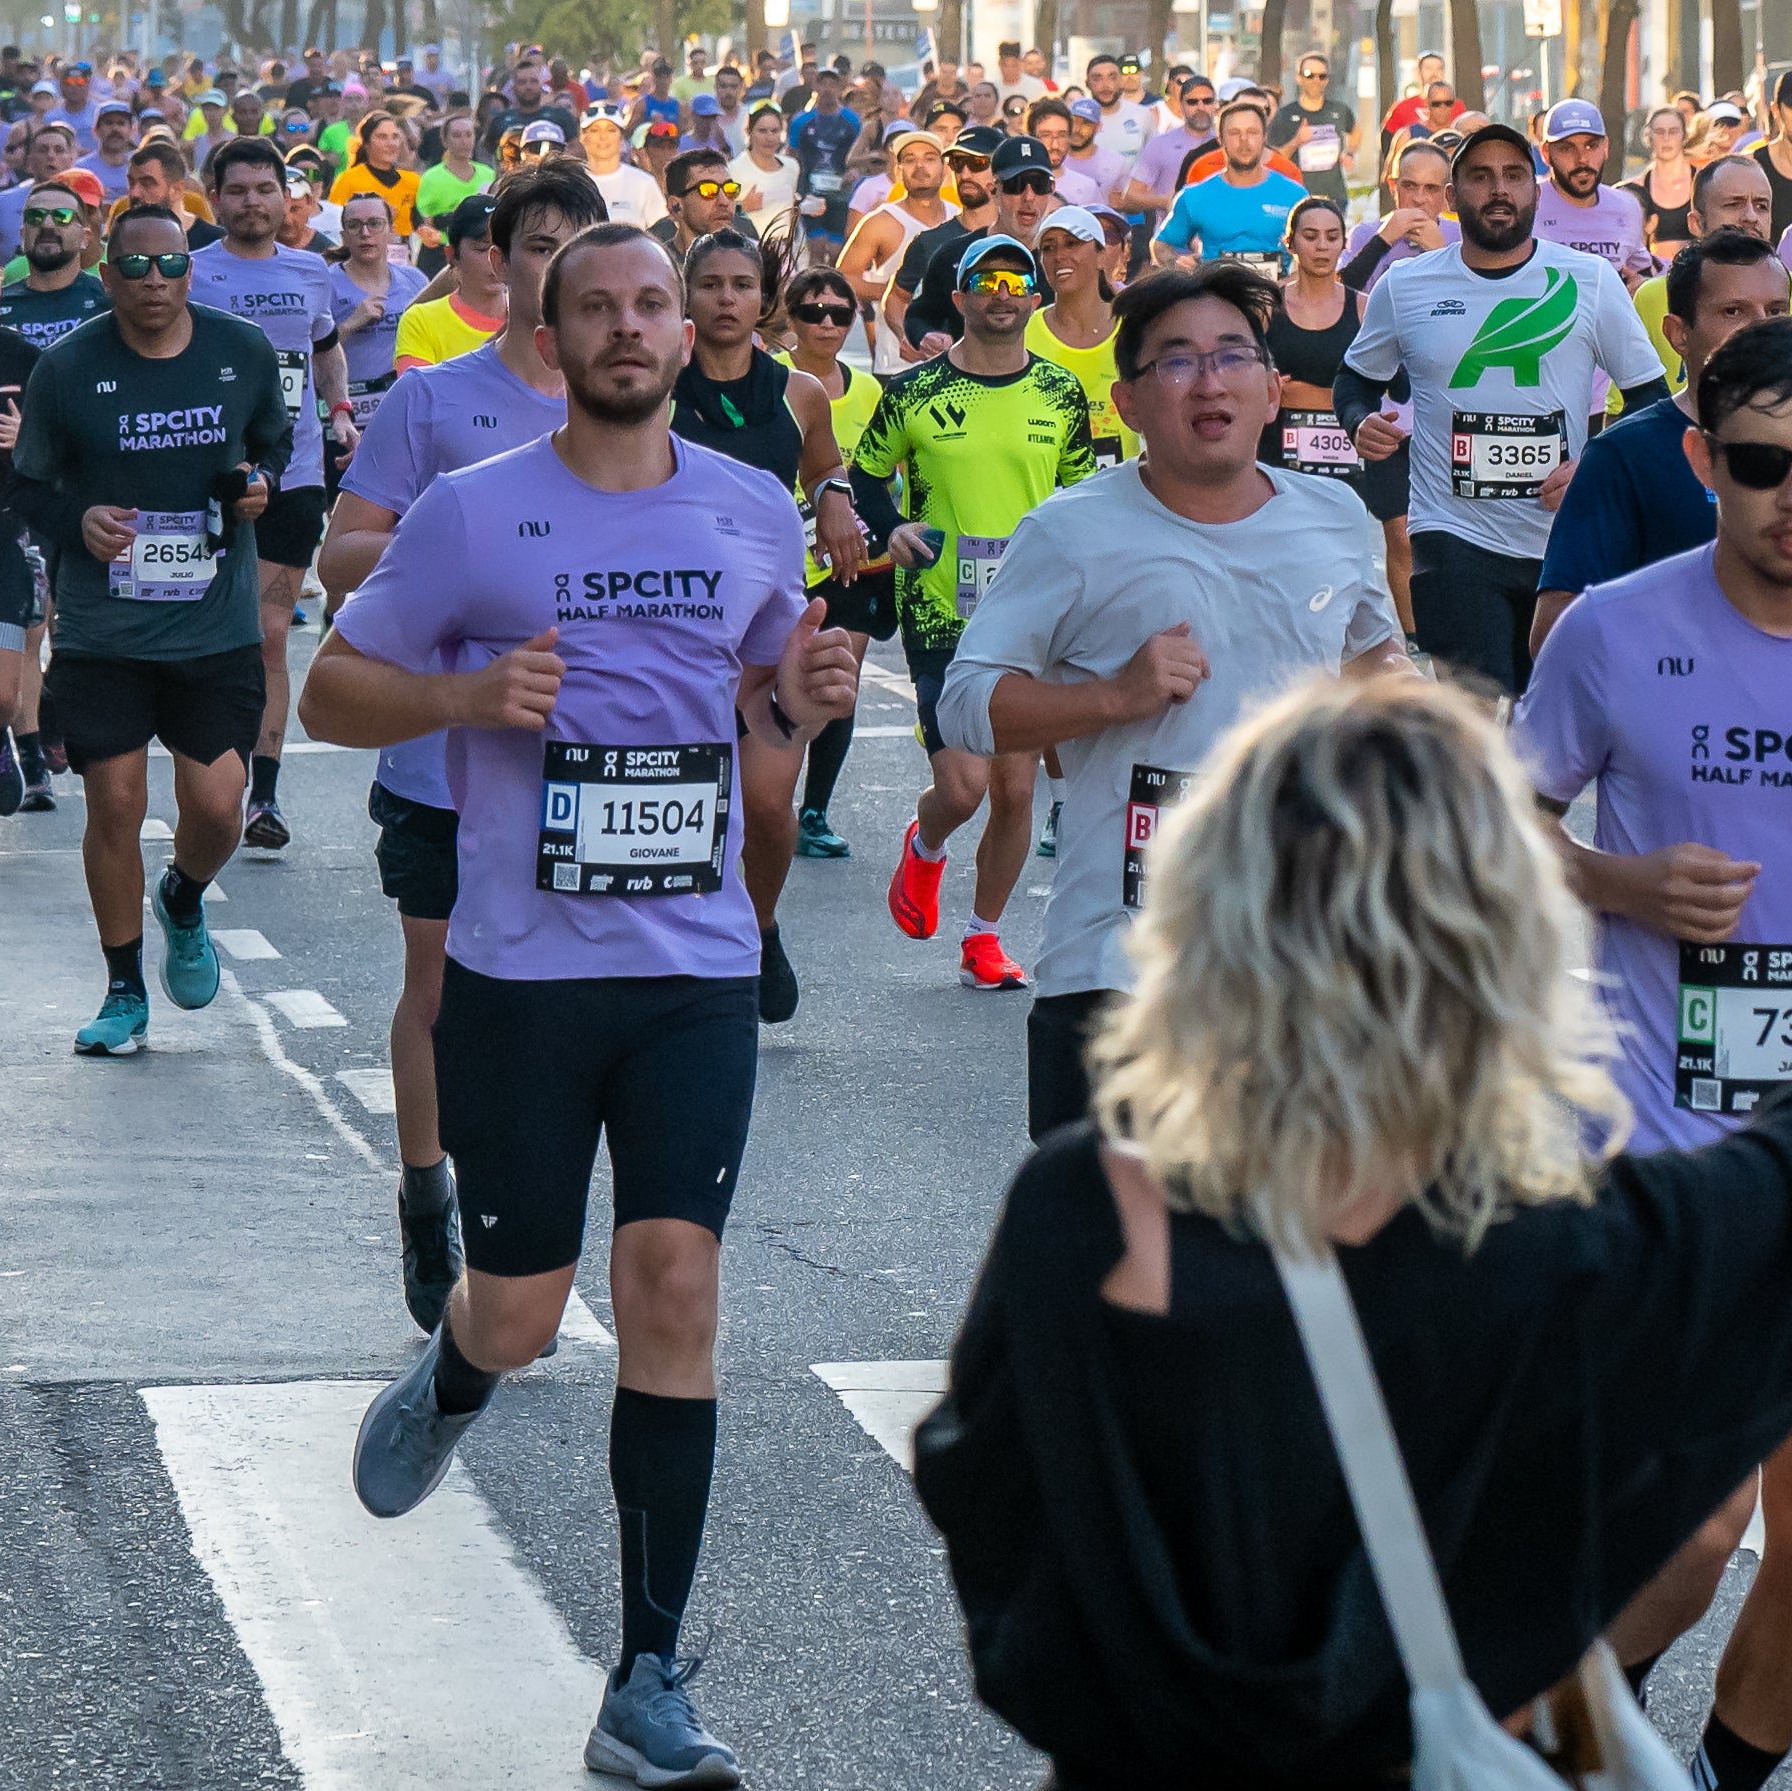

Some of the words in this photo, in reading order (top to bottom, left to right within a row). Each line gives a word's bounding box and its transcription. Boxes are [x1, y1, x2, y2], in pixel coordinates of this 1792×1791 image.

[243, 292, 305, 307] SPCITY
[21, 317, 82, 338] SPCITY
[96, 380, 117, 394] nu
[135, 405, 223, 433] SPCITY
[473, 414, 497, 429] nu
[1497, 416, 1536, 427] SPCITY
[1497, 425, 1537, 433] MARATHON
[119, 427, 227, 451] MARATHON
[1286, 430, 1295, 444] B
[1309, 433, 1352, 452] 4305
[1456, 439, 1467, 457] B
[1487, 444, 1552, 466] 3365
[1505, 471, 1534, 479] DANIEL
[159, 515, 196, 526] SPCITY
[518, 520, 551, 538] nu
[962, 563, 973, 580] C
[582, 569, 724, 601] SPCITY
[557, 604, 609, 622] HALF
[616, 602, 724, 621] MARATHON
[1657, 656, 1695, 676] nu
[565, 747, 590, 762] nu
[625, 750, 681, 766] SPCITY
[624, 767, 681, 778] MARATHON
[1146, 771, 1166, 787] nu
[1691, 764, 1753, 785] HALF
[551, 791, 572, 821] D
[601, 798, 705, 836] 11504
[1134, 812, 1151, 841] B
[542, 842, 575, 857] 21.1K
[629, 847, 681, 859] GIOVANE
[1700, 947, 1726, 964] nu
[1687, 997, 1708, 1031] C
